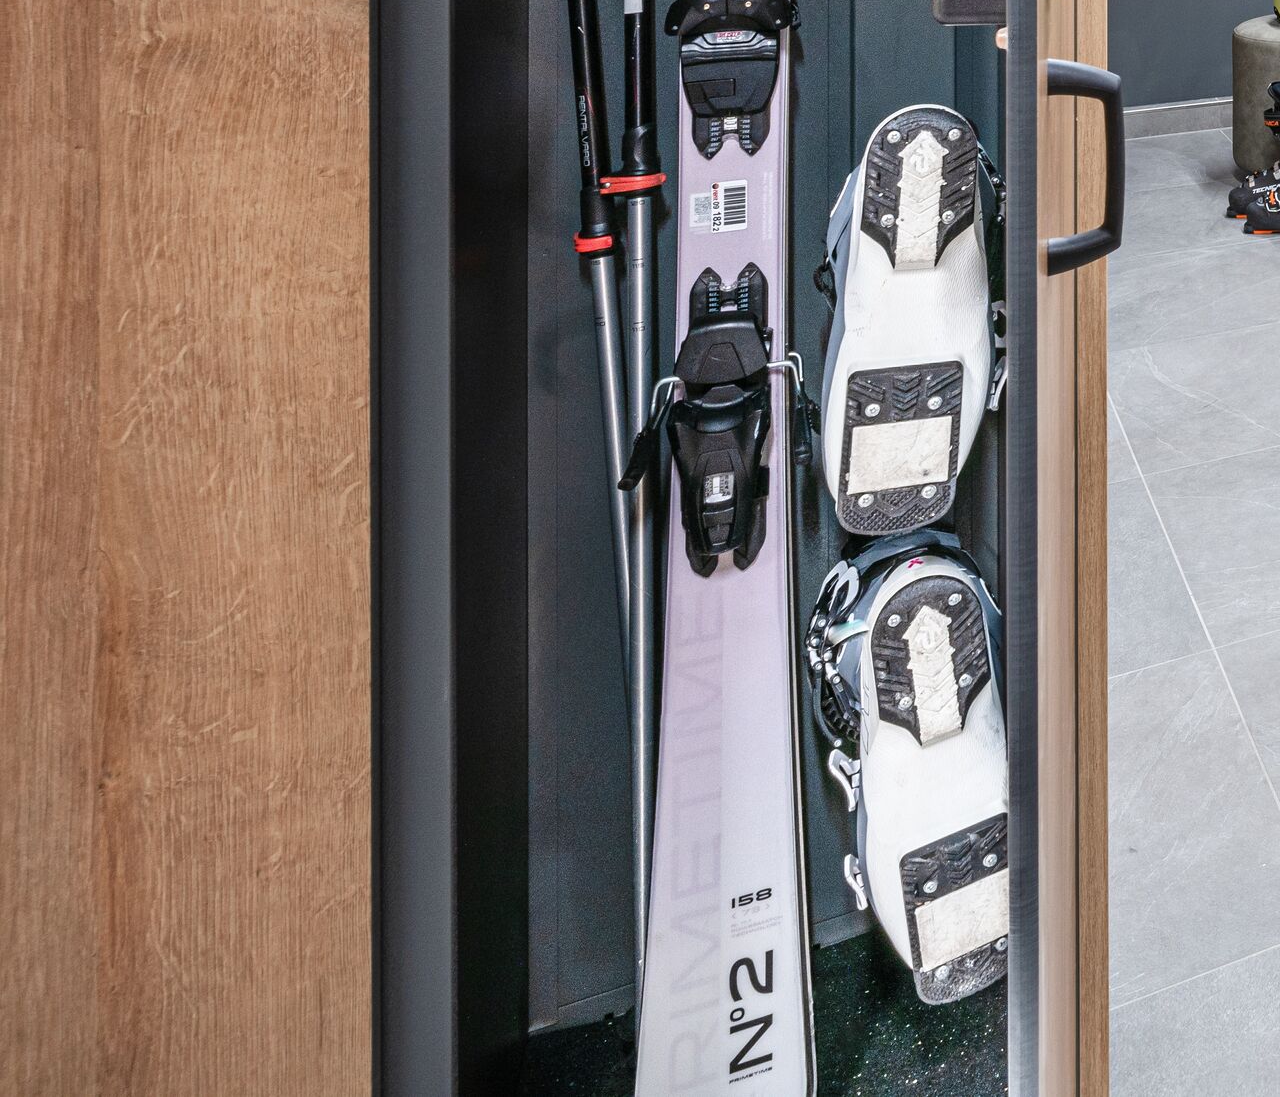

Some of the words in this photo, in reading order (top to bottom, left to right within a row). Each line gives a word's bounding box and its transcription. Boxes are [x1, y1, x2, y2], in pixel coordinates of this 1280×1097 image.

[579, 95, 588, 135] RENTAL
[582, 136, 591, 167] VARIO
[1252, 183, 1280, 194] TECNICA
[731, 887, 772, 909] 158
[729, 1066, 773, 1085] PRIMETIME
